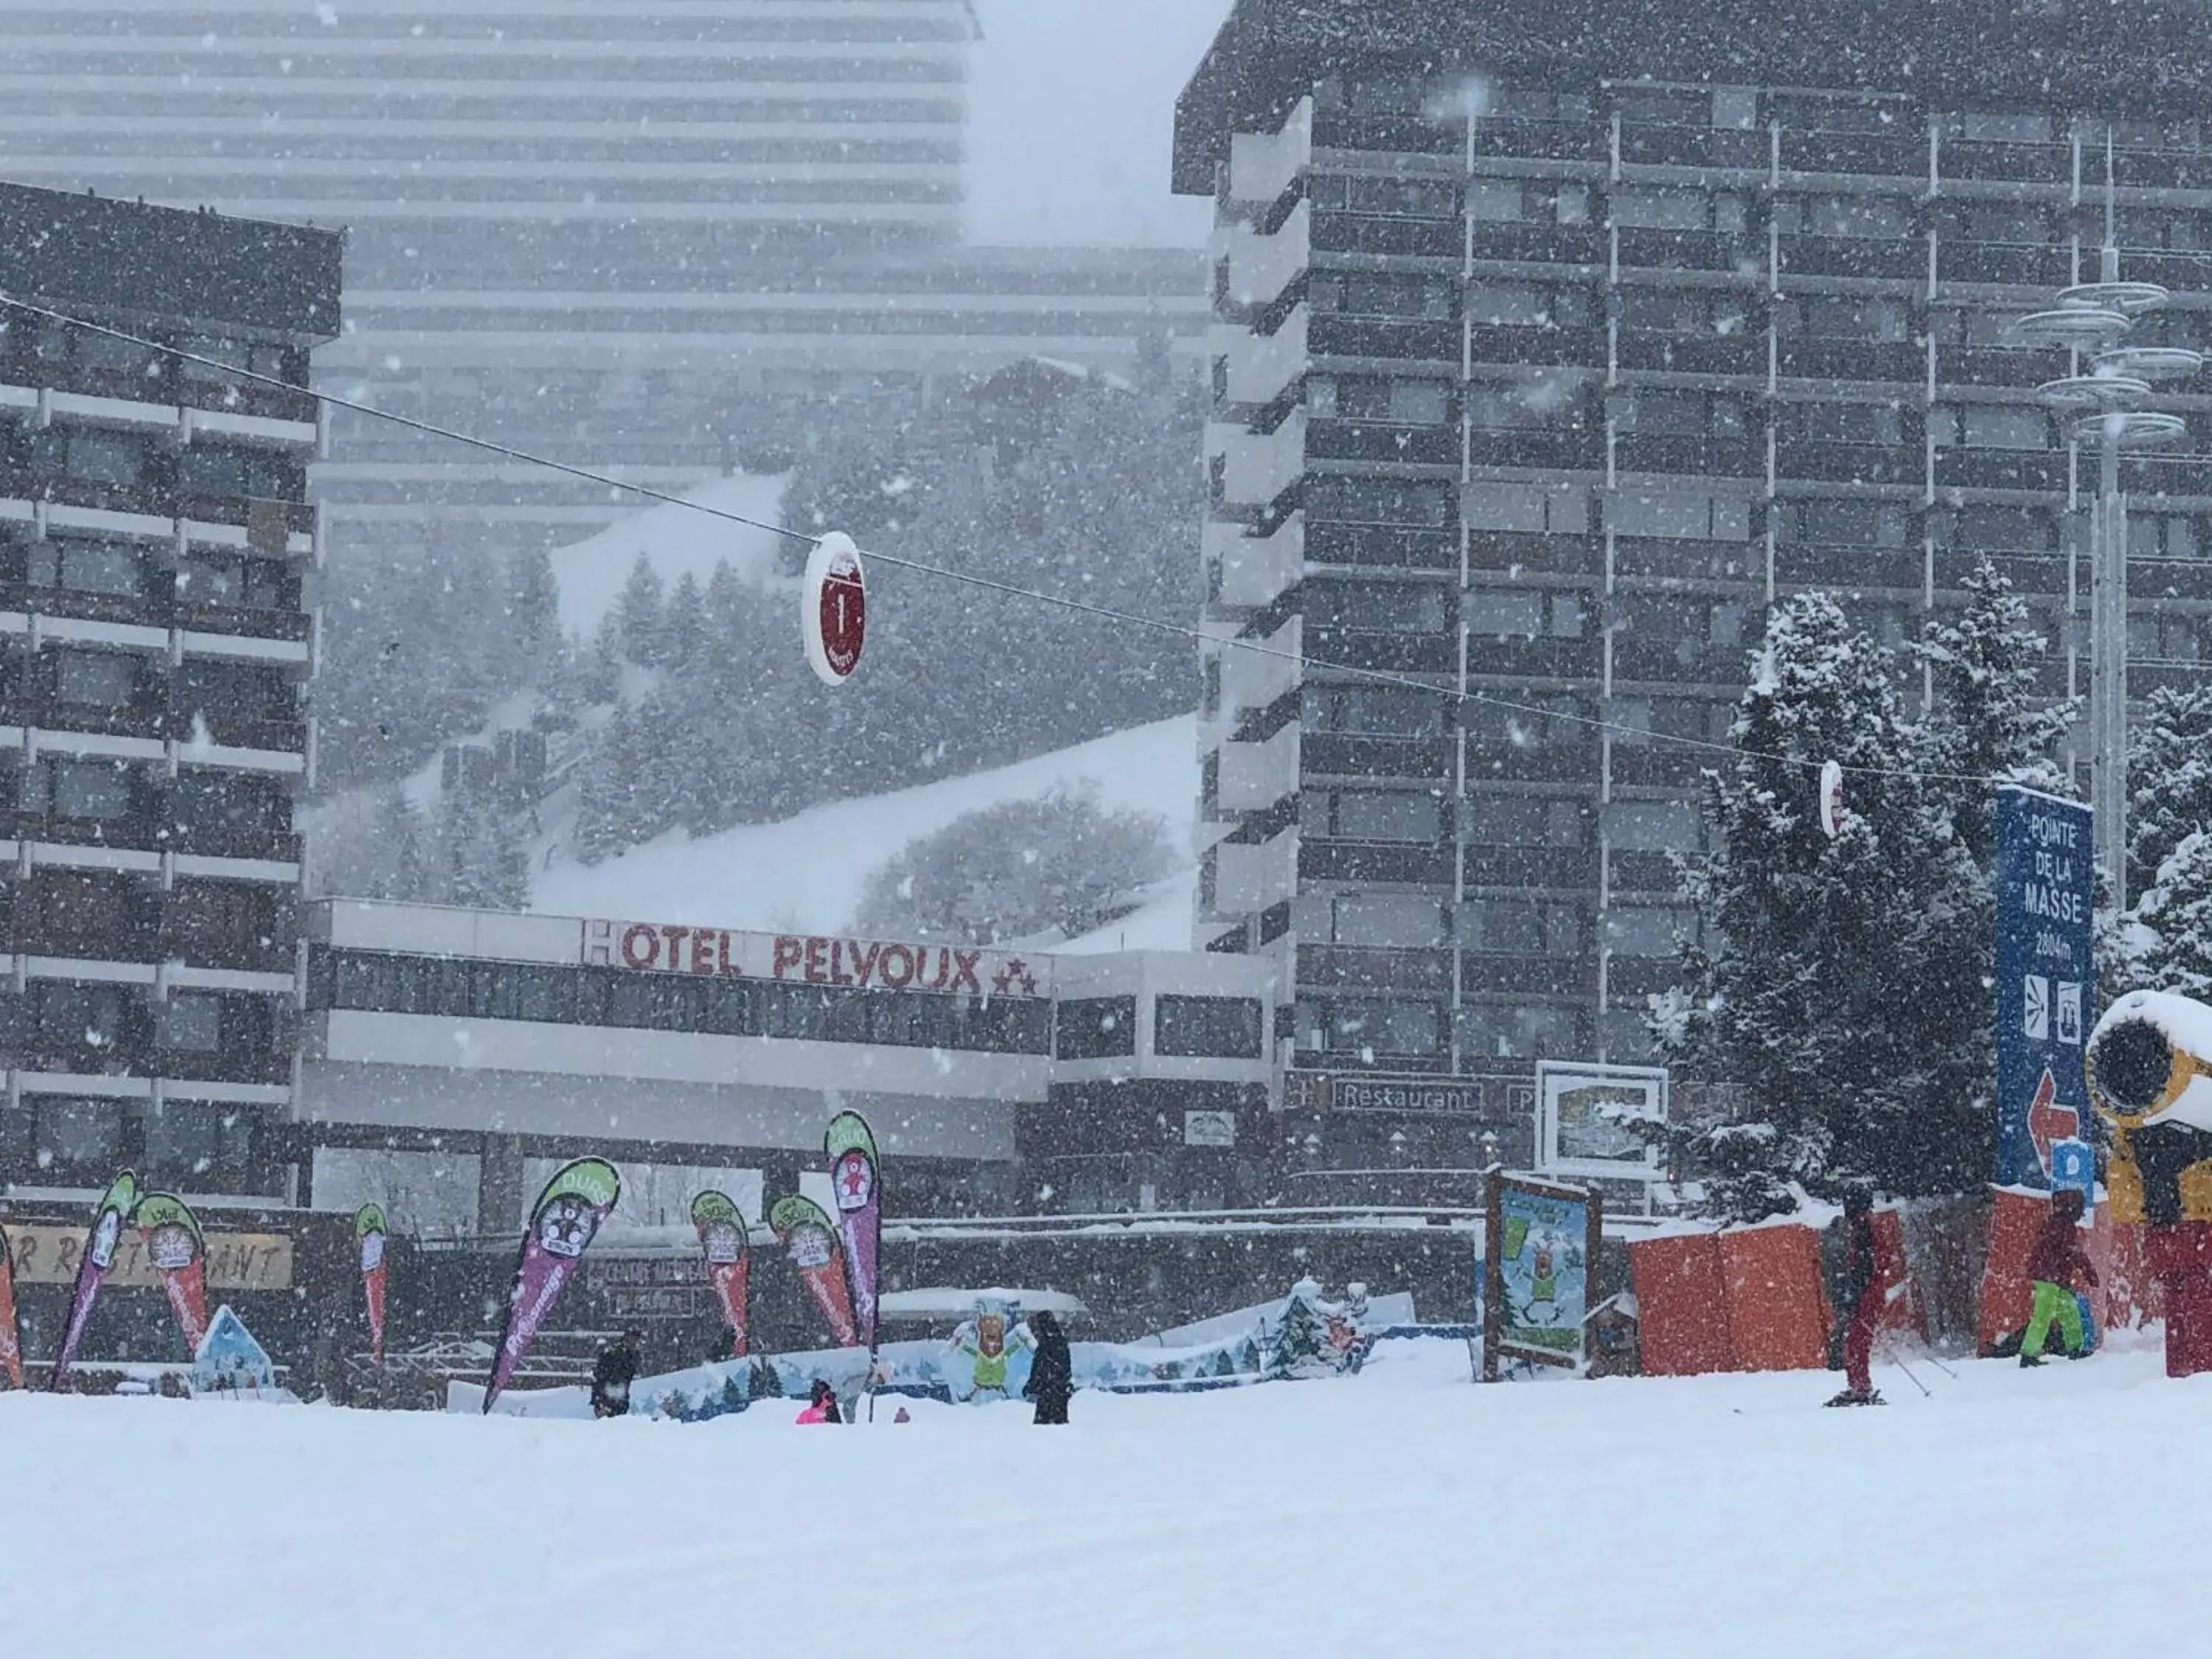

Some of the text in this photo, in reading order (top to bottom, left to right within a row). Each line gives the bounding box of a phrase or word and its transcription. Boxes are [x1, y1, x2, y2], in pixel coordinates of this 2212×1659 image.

[2030, 813, 2078, 849] POINTE
[2035, 850, 2073, 883] DE LA
[2025, 882, 2083, 924] MASSE
[581, 919, 981, 995] HOTEL PELVOUX
[1344, 1084, 1472, 1110] Restaurant
